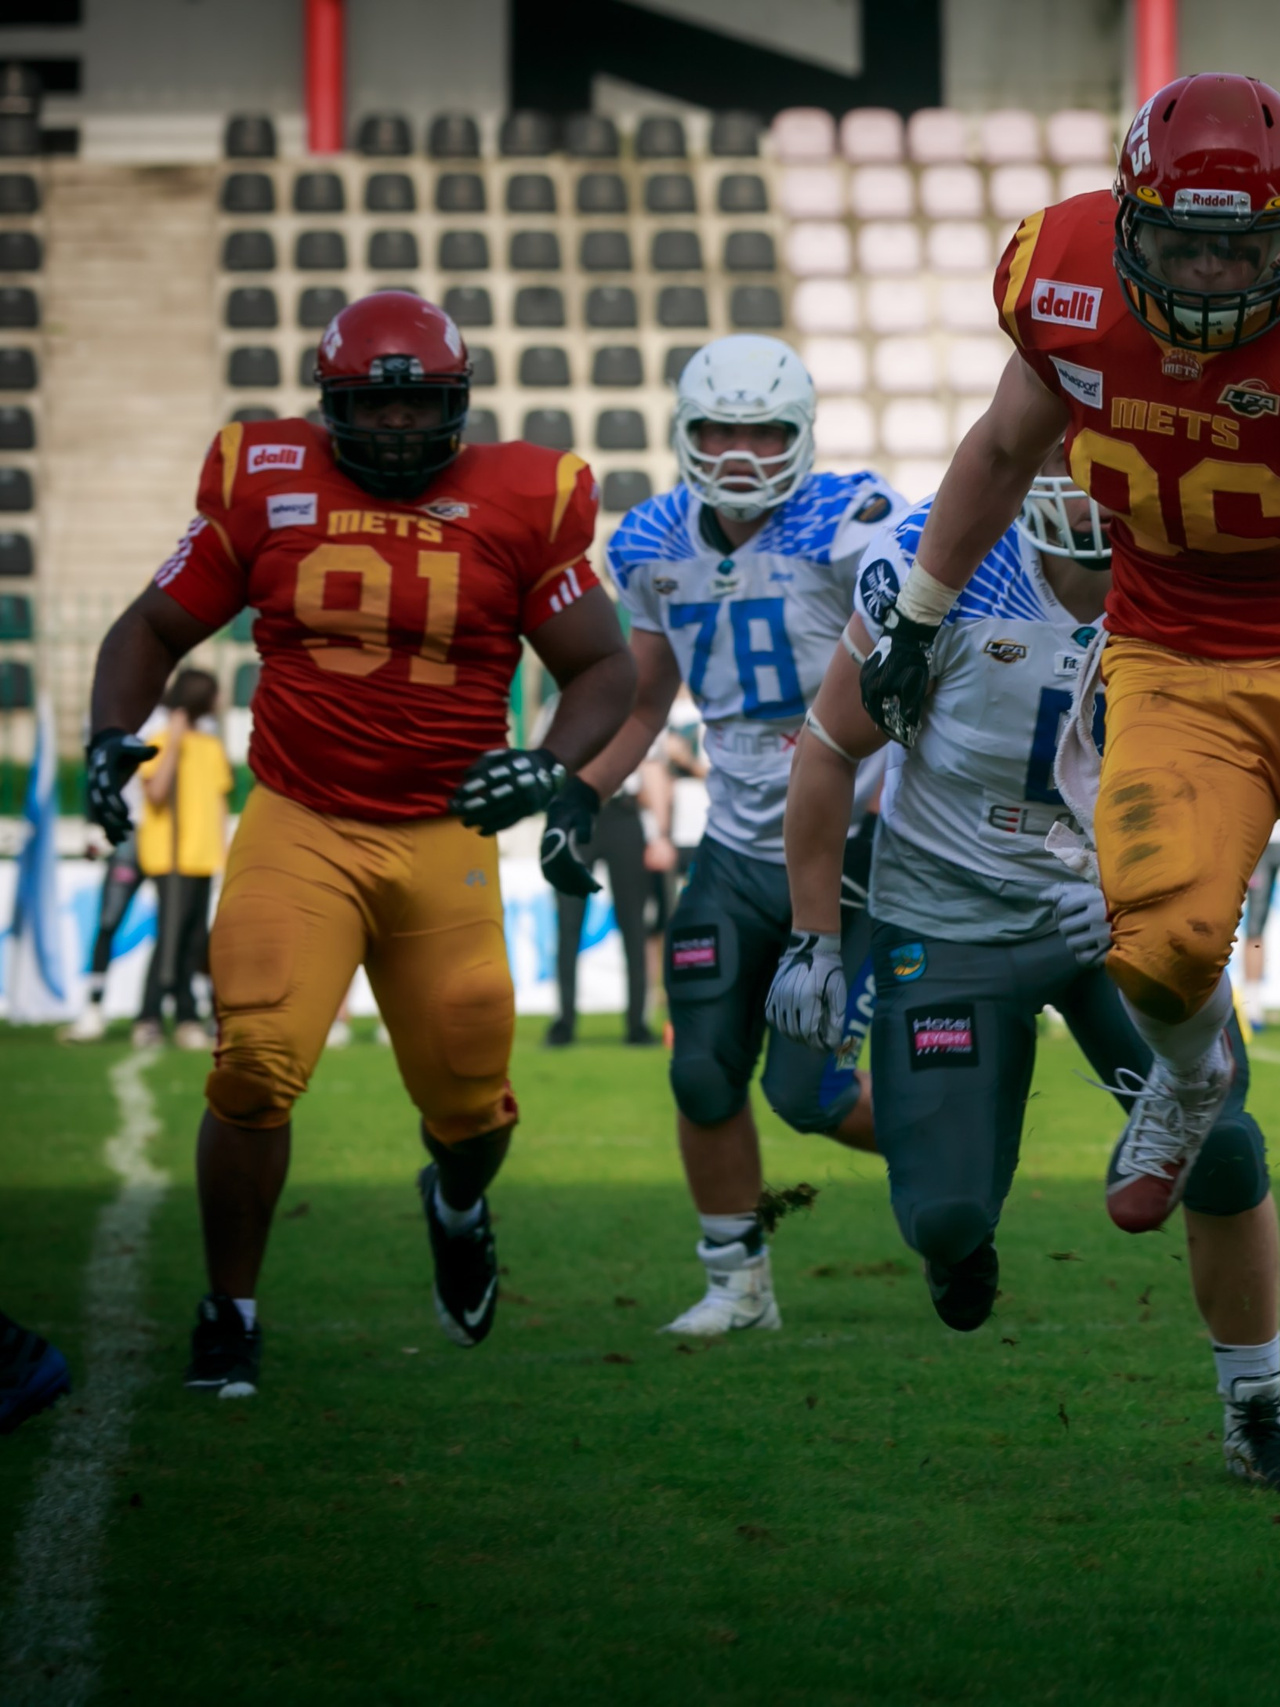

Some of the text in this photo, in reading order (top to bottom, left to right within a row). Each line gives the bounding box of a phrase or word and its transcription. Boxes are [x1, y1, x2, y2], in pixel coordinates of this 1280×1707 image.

[1192, 193, 1234, 207] Riddell
[1037, 287, 1095, 322] dalli
[1226, 391, 1274, 410] LFA
[1111, 397, 1240, 450] METS
[254, 448, 298, 467] dalli
[327, 510, 443, 543] METS
[294, 543, 461, 686] 91
[668, 597, 806, 720] 78
